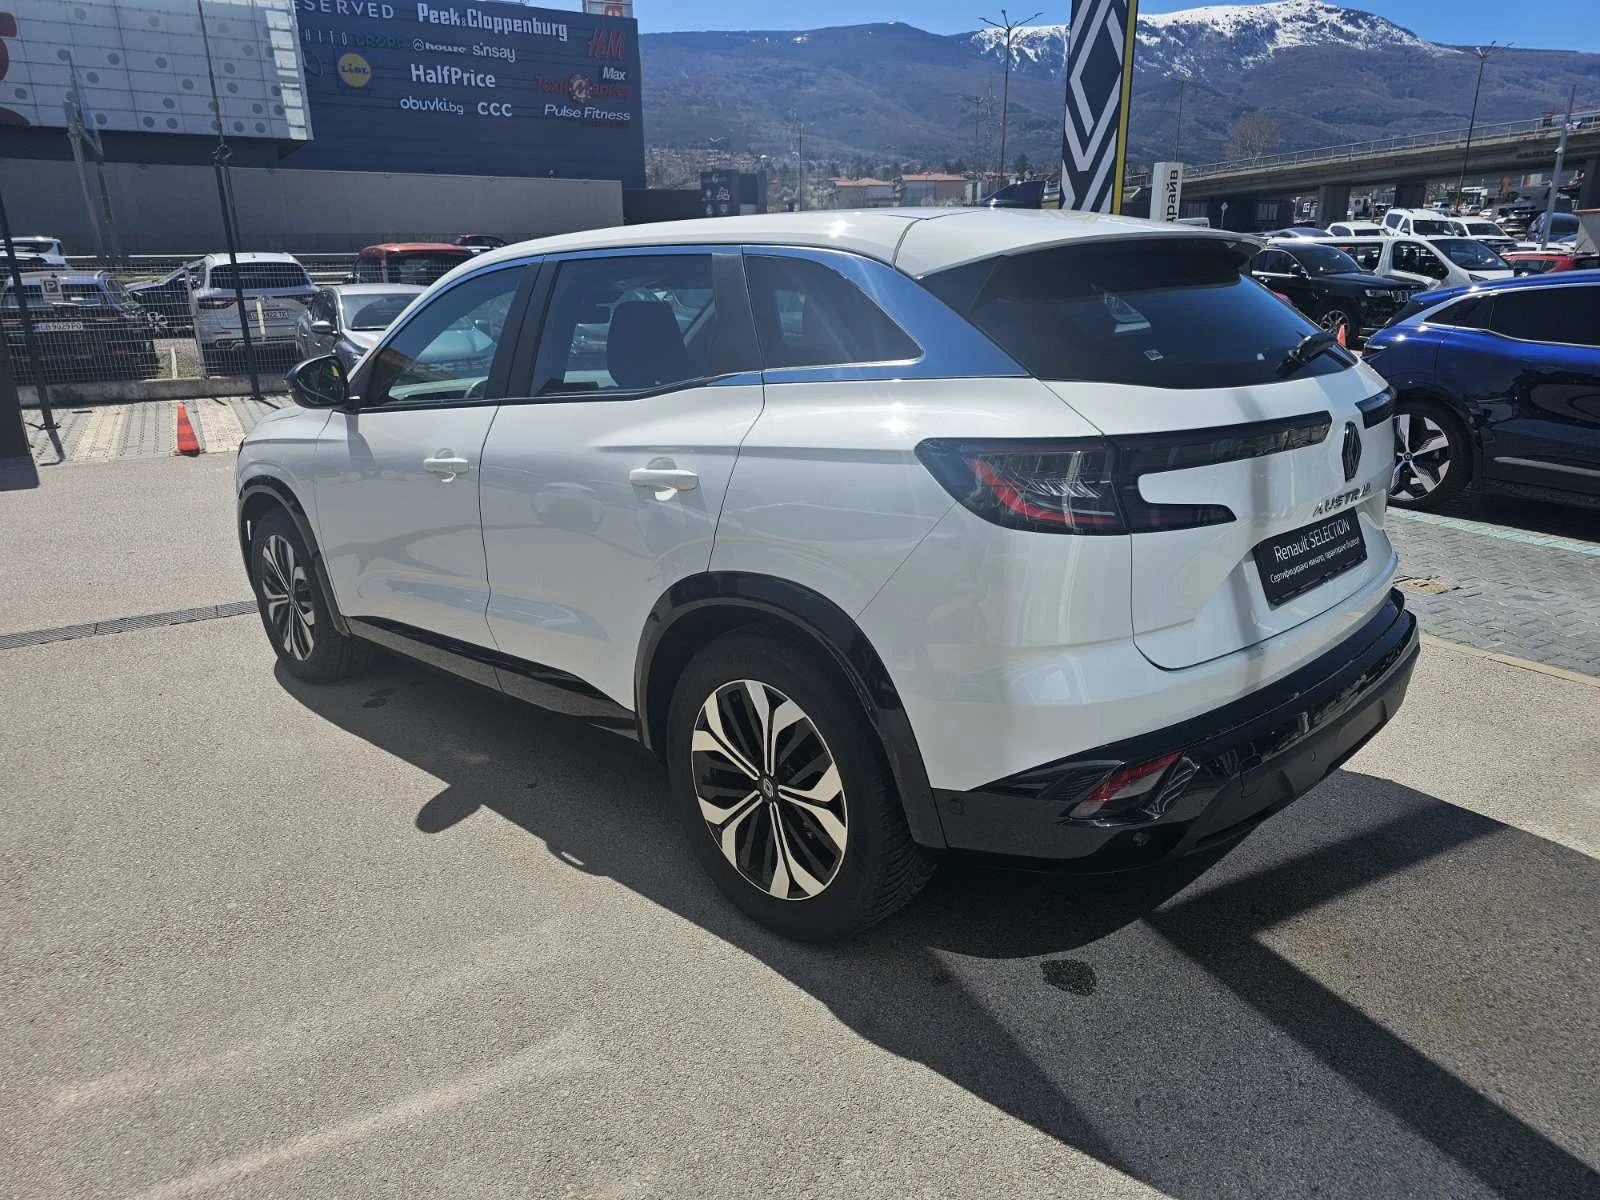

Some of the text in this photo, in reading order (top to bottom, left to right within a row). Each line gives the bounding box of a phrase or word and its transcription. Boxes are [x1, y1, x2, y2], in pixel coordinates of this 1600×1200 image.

[472, 42, 516, 63] sinsay
[410, 63, 496, 88] HalfPrice
[602, 66, 626, 80] Max
[400, 96, 464, 115] obuvki.bg
[544, 103, 632, 121] Pulse Fitness
[1273, 518, 1350, 563] Renault SELECTION
